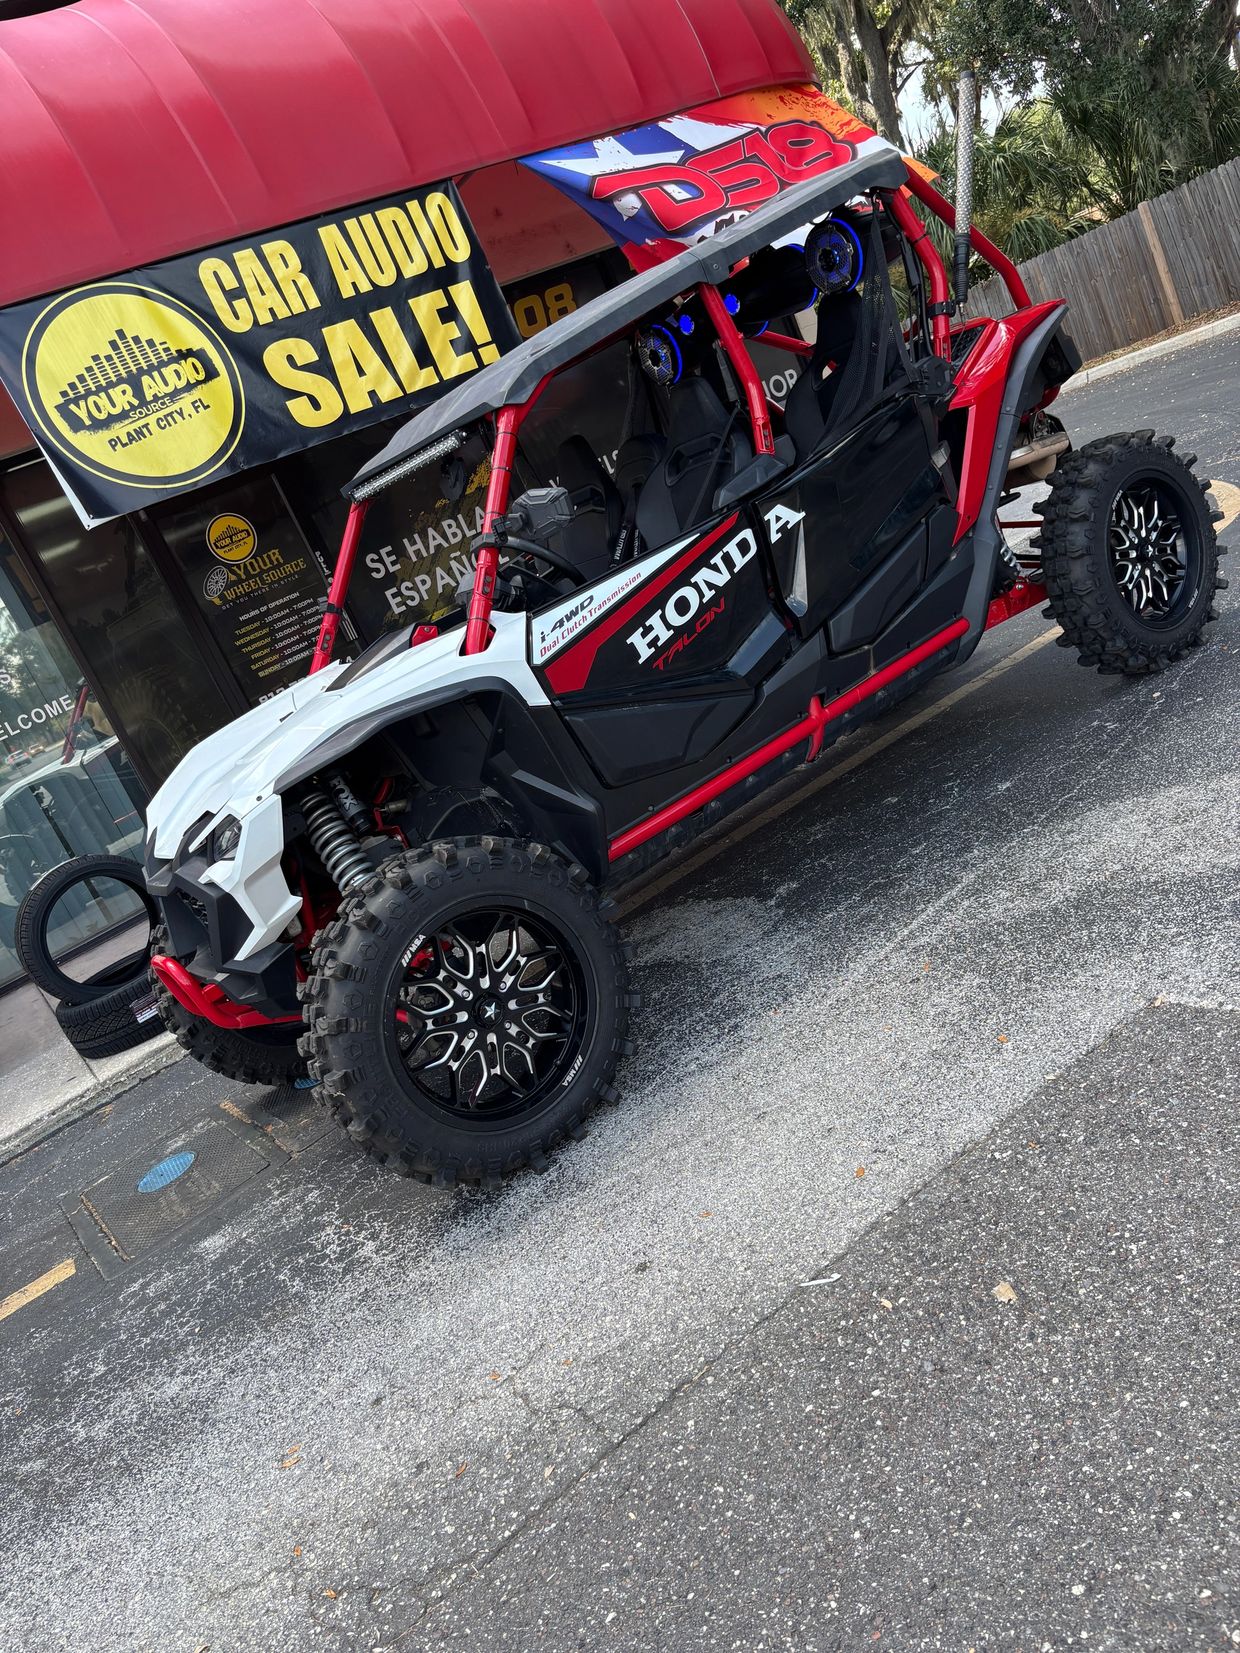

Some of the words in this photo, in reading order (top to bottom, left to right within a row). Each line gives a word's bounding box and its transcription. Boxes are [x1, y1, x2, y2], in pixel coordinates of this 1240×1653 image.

[592, 122, 854, 231] DS18
[198, 239, 321, 333] CAR
[317, 192, 471, 299] AUDIO
[263, 280, 501, 428] SALE!
[69, 384, 140, 427] YOUR
[141, 356, 206, 401] AUDIO
[761, 369, 798, 398] OP
[108, 422, 155, 451] PLANT
[156, 406, 192, 431] CITY,
[191, 398, 211, 413] FL
[129, 396, 174, 420] SOURCE
[216, 537, 231, 549] YOUR
[232, 530, 248, 543] AUDIO
[223, 577, 268, 600] WHEEL
[262, 557, 307, 583] SOURCE
[231, 548, 283, 579] YOUR
[365, 545, 401, 580] SE
[384, 550, 510, 615] ESPAÑL
[626, 504, 806, 665] HONDA
[235, 620, 261, 635] TUESDAY
[264, 608, 290, 623] 10:00AM
[239, 609, 260, 621] HOURS
[268, 592, 300, 609] OPERATION
[540, 634, 559, 658] Dual
[561, 614, 588, 642] Clutch
[587, 571, 642, 620] Transmission
[540, 594, 595, 644] i-4WD
[235, 627, 270, 646] WEDNESDAY
[273, 615, 299, 629] 10:00AM
[241, 636, 271, 653] THURSDAY
[275, 624, 301, 639] 10:00AM
[251, 648, 271, 660] FRIDAY
[274, 634, 300, 650] 10:00AM
[652, 597, 725, 671] TALON
[250, 654, 279, 671] SATURDAY
[283, 640, 308, 655] 10:00AM
[258, 663, 280, 678] SUNDAY
[284, 650, 309, 666] 10:00AM
